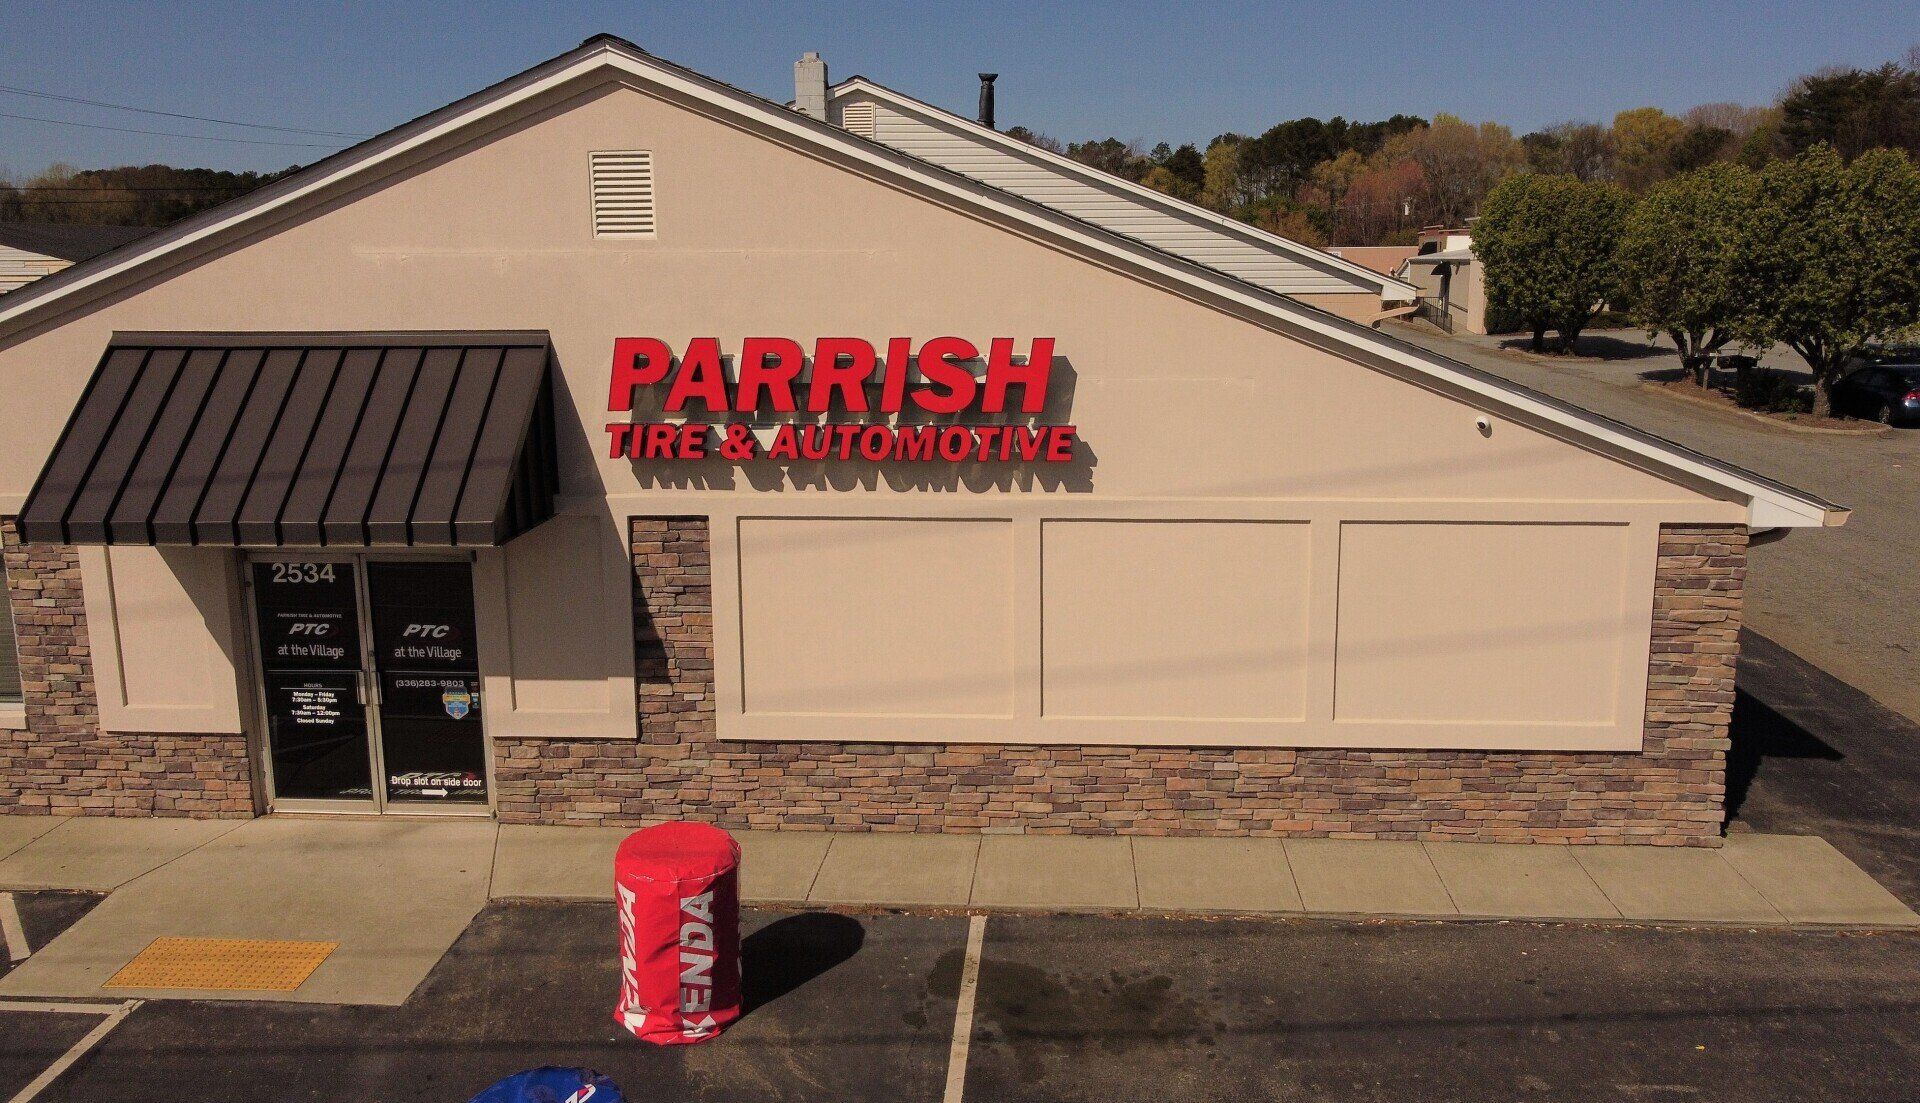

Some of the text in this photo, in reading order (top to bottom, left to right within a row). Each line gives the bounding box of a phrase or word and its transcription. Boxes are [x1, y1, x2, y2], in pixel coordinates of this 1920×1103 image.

[607, 336, 1055, 414] PARRISH
[605, 423, 1077, 462] TIRE & AUTOMOTIVE
[272, 563, 336, 583] 2534
[289, 623, 330, 635] PTC
[402, 624, 450, 638] PTC
[277, 644, 344, 659] at the Village
[394, 646, 462, 661] at the Village
[395, 680, 464, 688] (336)283-9803
[391, 775, 411, 787] Drop
[414, 776, 429, 786] slot
[431, 778, 442, 786] on
[444, 777, 460, 786] side
[463, 778, 482, 787] door
[679, 890, 717, 1038] KENDA
